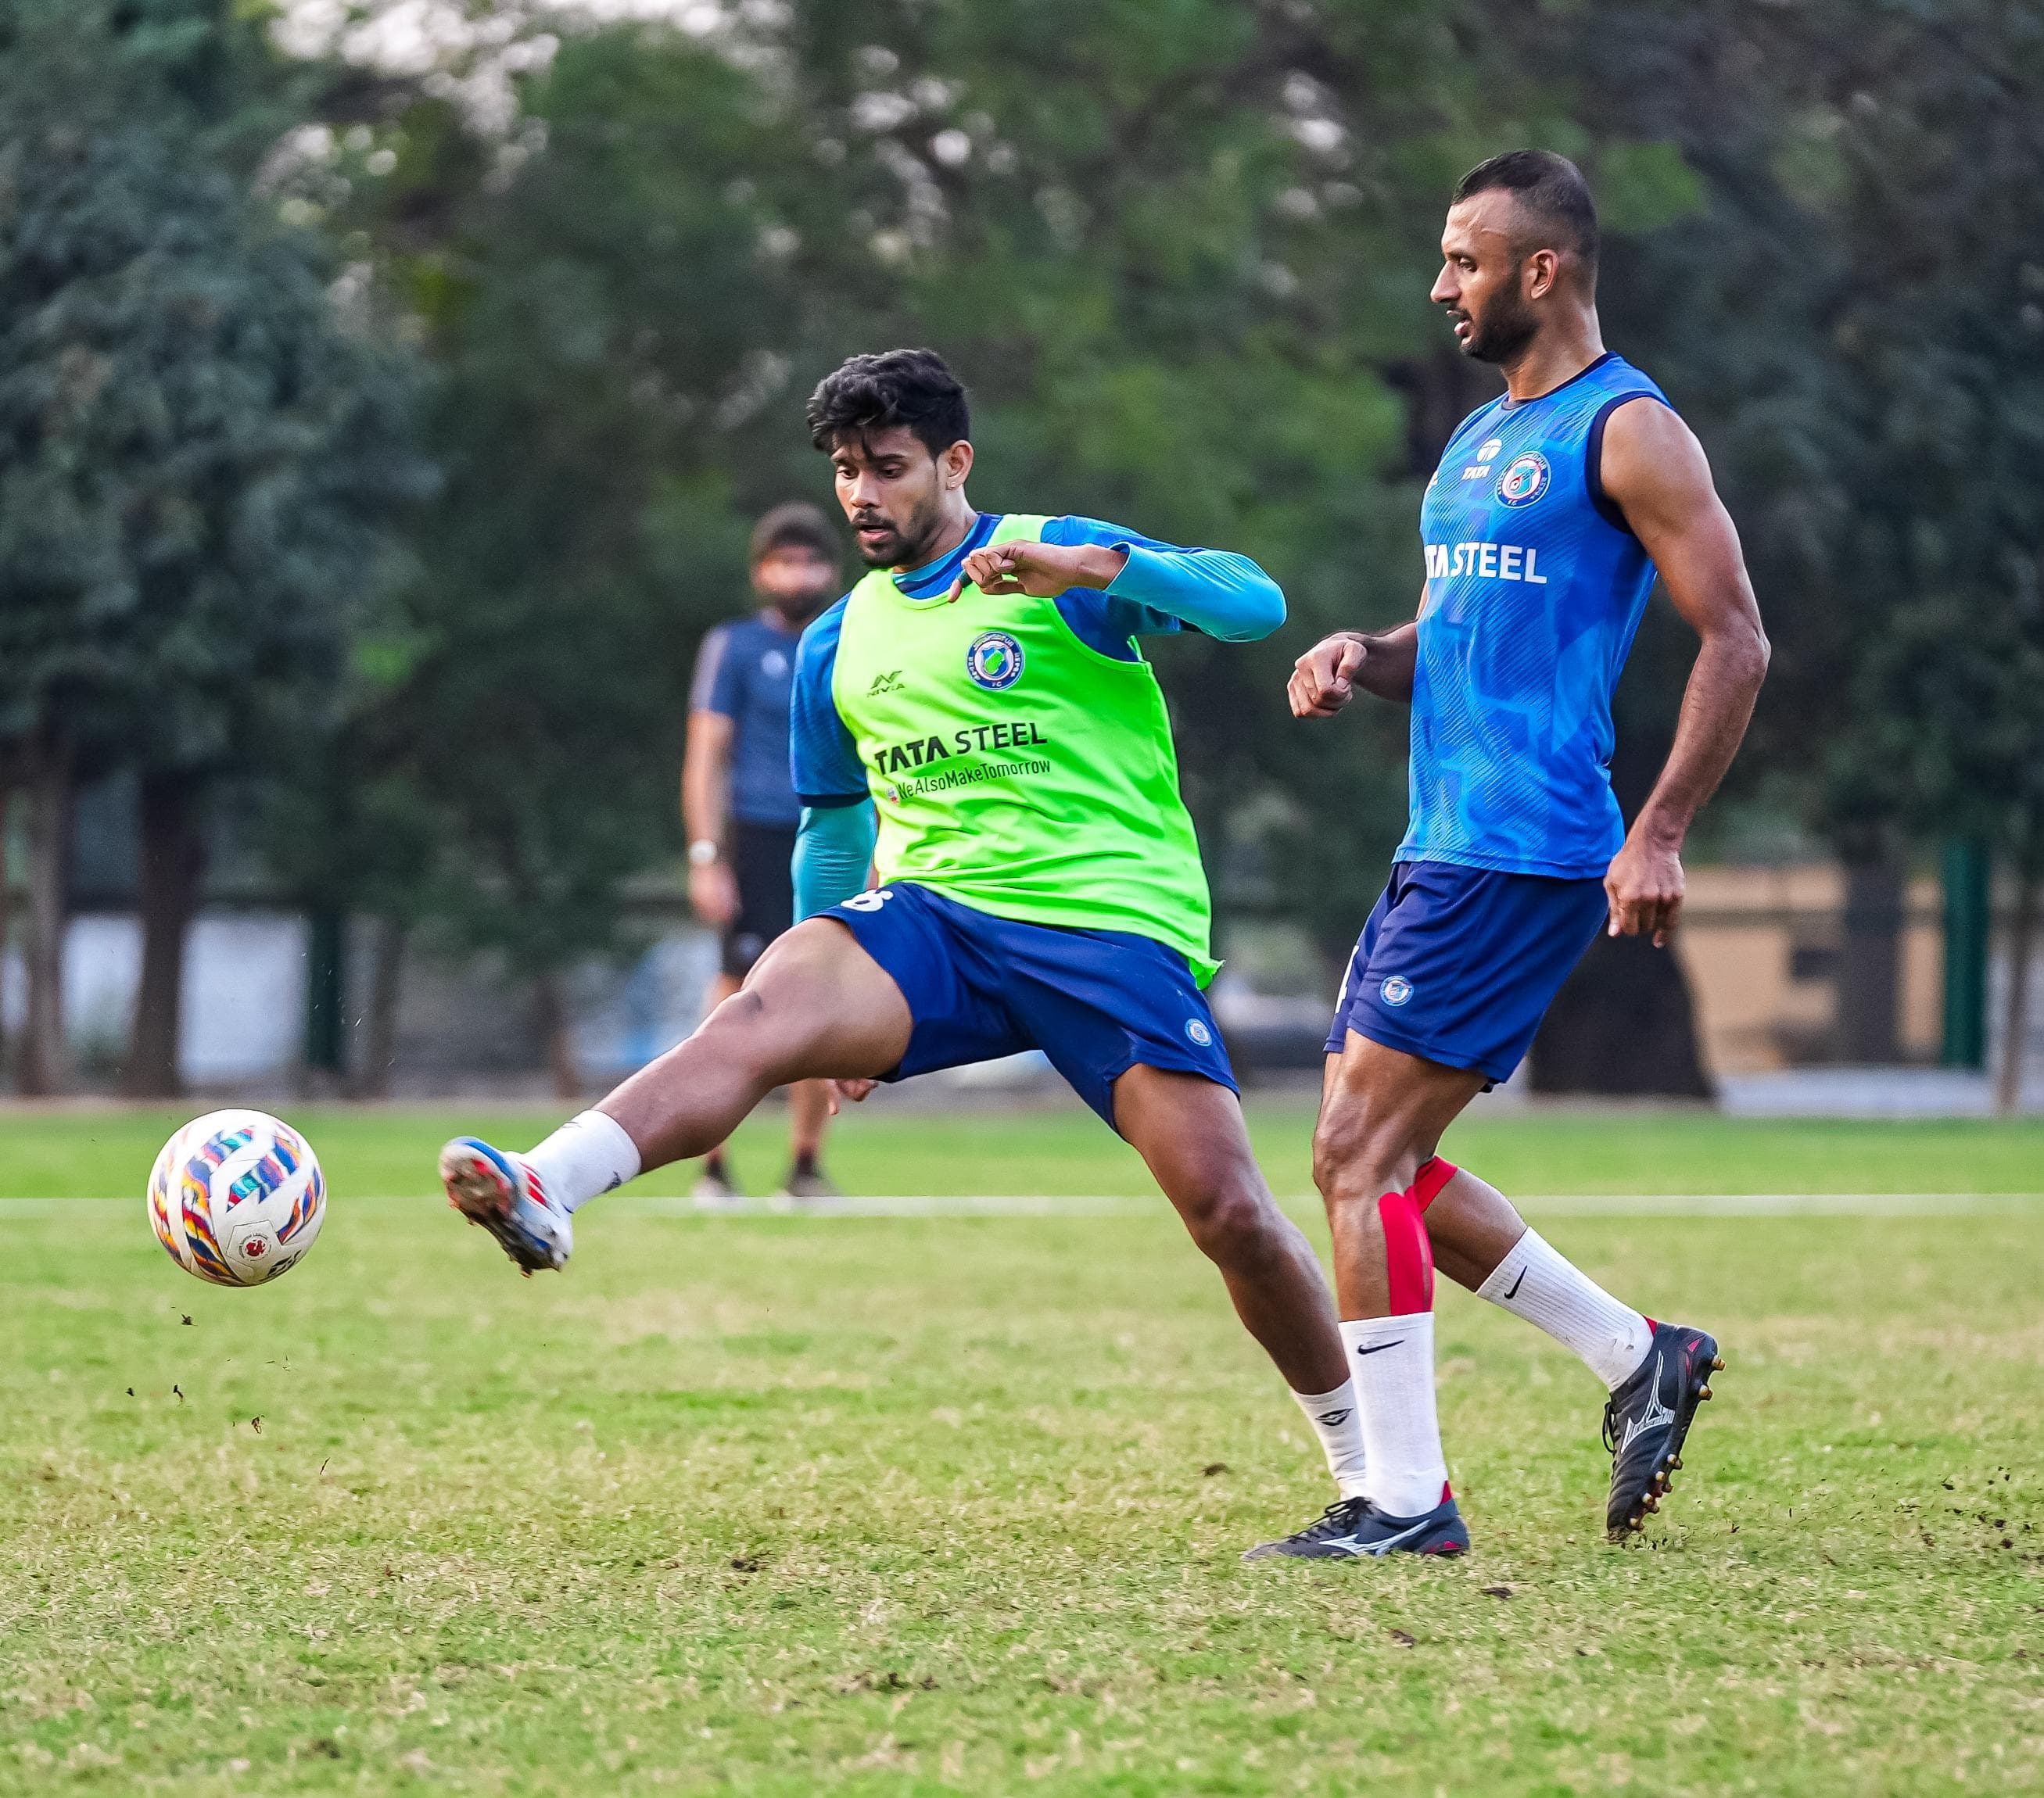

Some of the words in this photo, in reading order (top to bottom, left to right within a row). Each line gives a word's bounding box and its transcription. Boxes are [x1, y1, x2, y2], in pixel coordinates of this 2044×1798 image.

[1461, 465, 1491, 480] TATA
[1424, 544, 1449, 578] TA
[1451, 542, 1547, 584] STEEL
[874, 736, 951, 775] TATA
[955, 722, 1048, 754] STEEL
